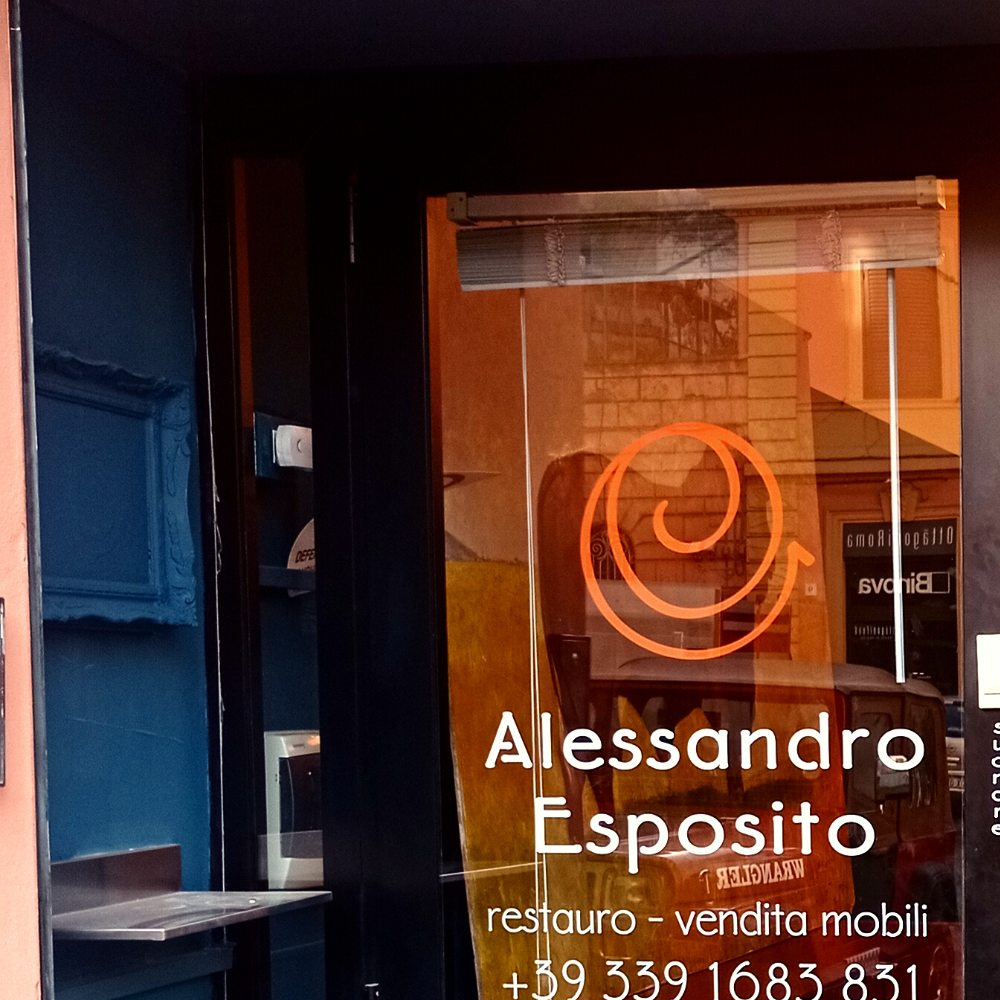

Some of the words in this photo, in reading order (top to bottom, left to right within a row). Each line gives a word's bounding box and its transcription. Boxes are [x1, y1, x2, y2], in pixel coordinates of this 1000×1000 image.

[296, 548, 315, 563] DEFE
[484, 711, 925, 771] Alessandro
[536, 796, 875, 874] Esposito
[487, 901, 636, 935] restauro
[674, 901, 807, 937] vendita
[822, 902, 928, 938] mobili
